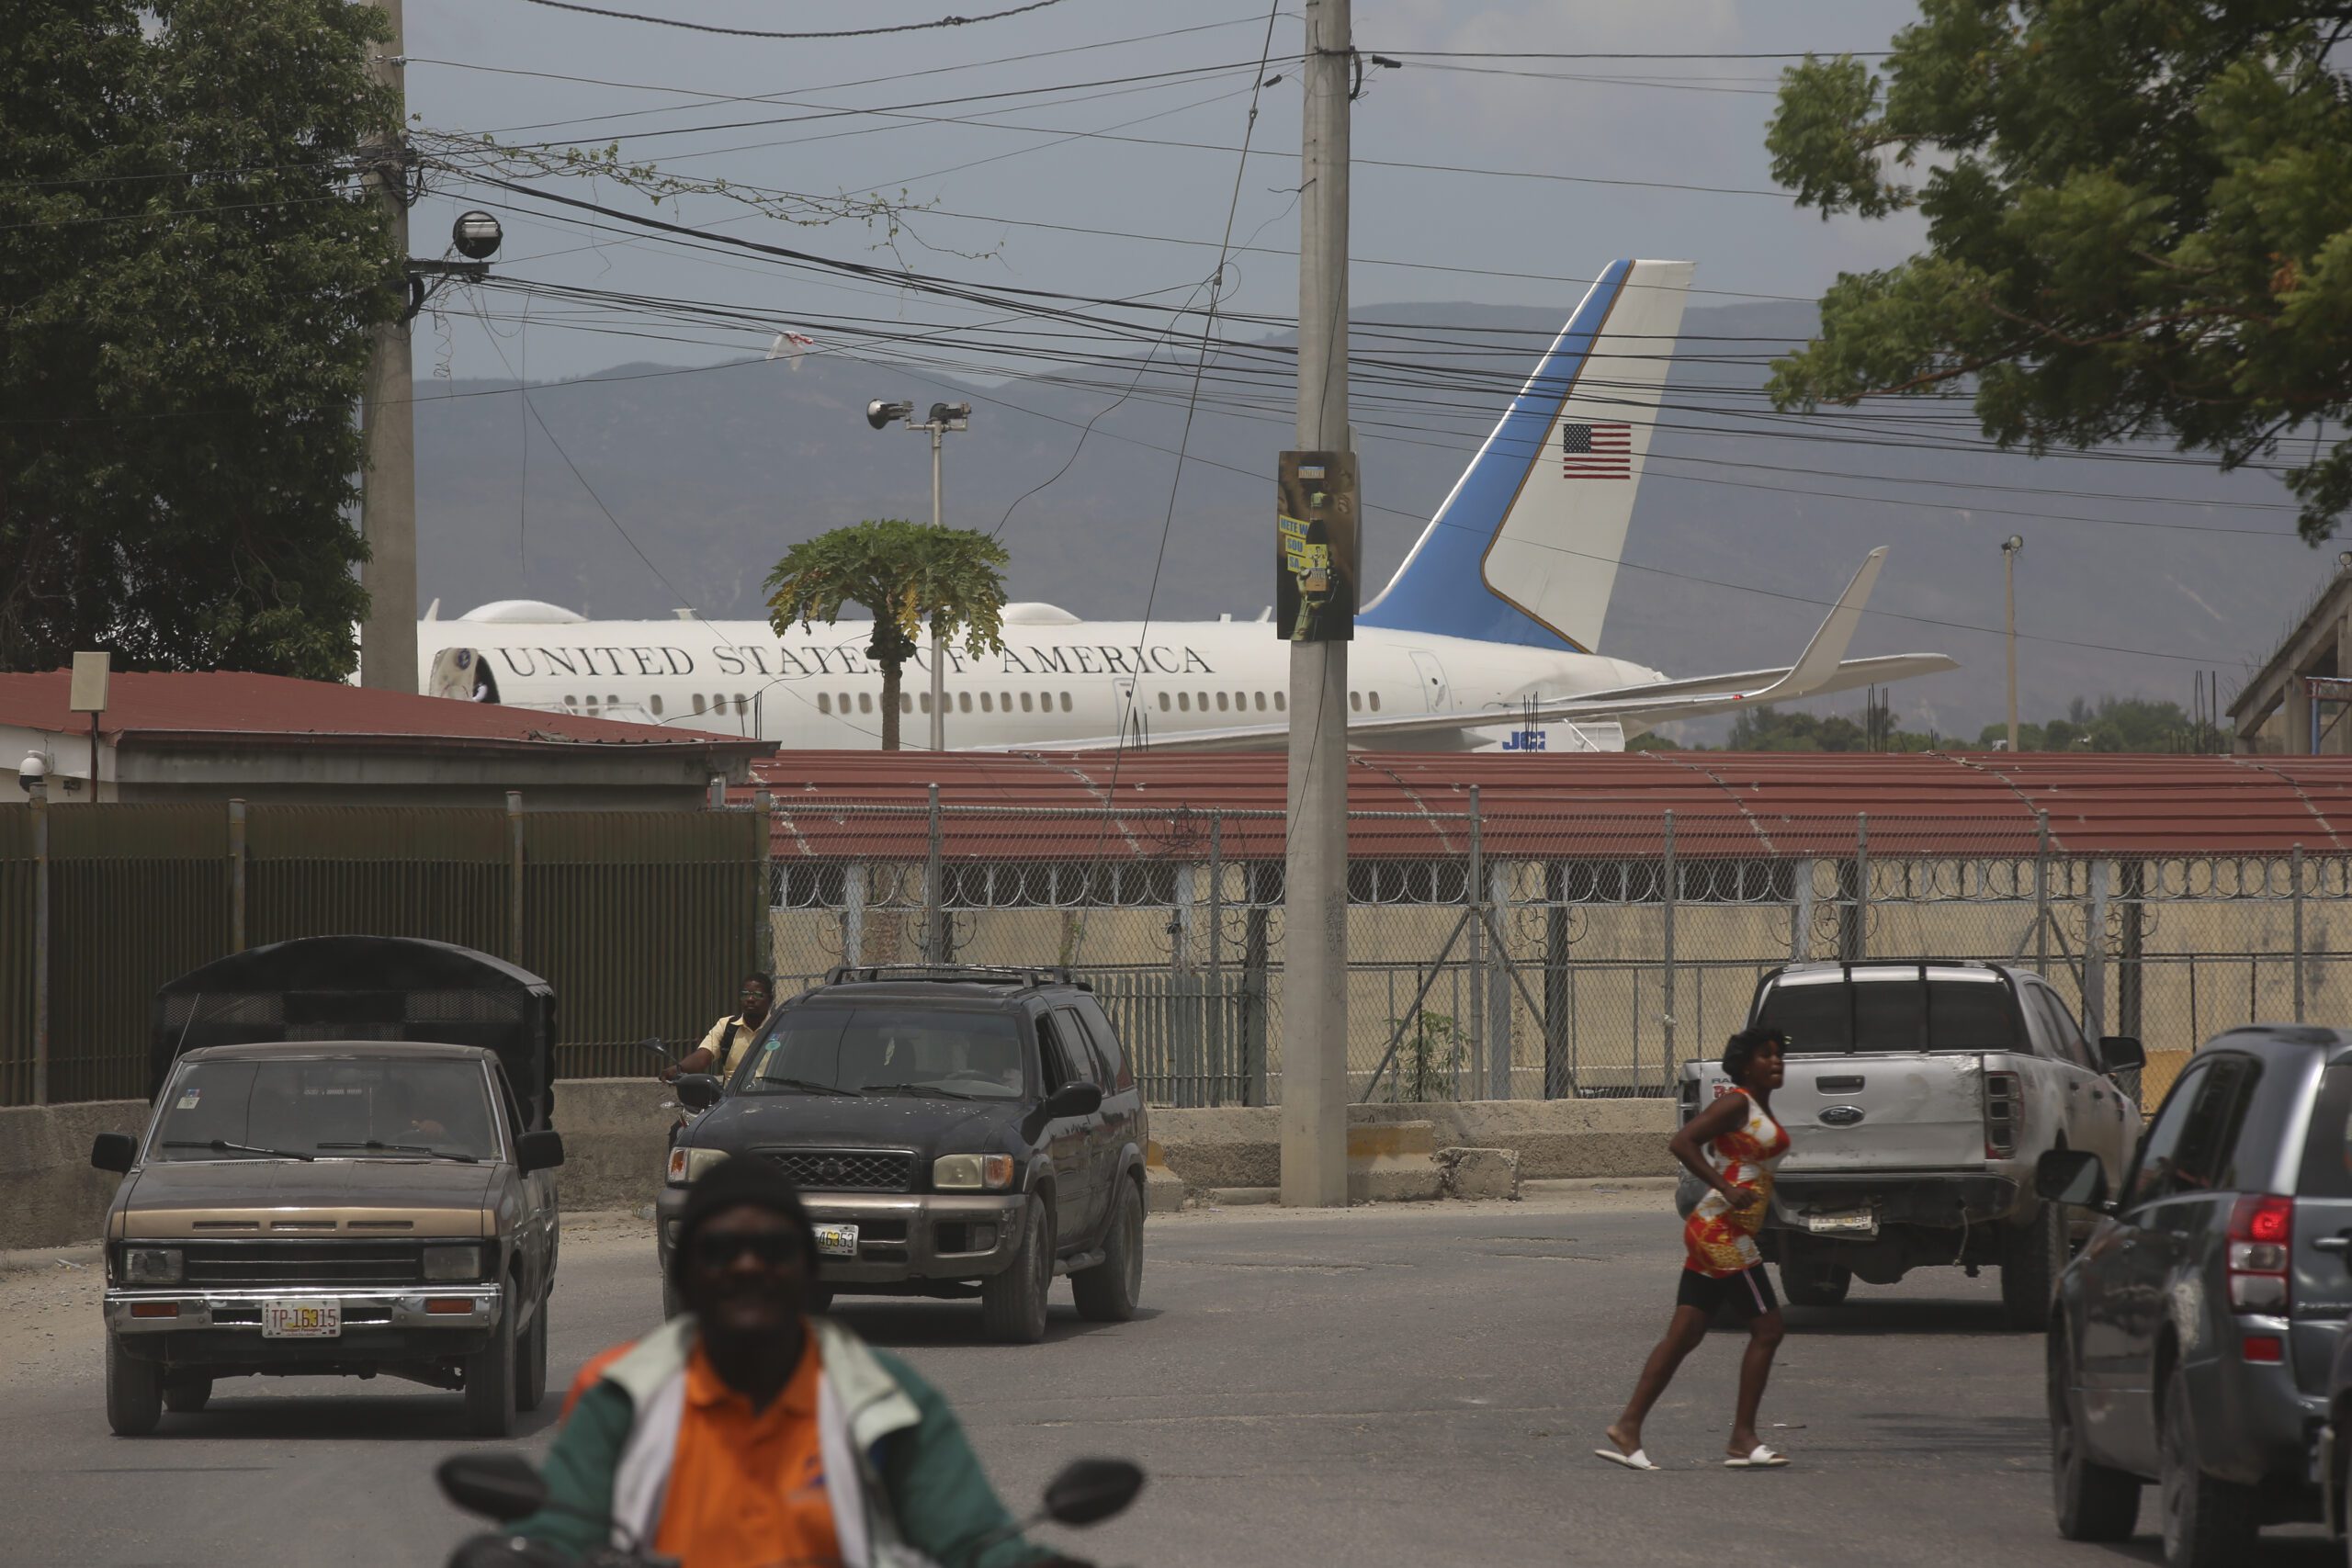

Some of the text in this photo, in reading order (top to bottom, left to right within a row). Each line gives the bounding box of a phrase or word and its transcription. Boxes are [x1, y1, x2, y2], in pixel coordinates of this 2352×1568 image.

[493, 647, 695, 677] UNITED
[1001, 646, 1216, 673] AMERICA
[271, 1309, 336, 1327] TP-16315
